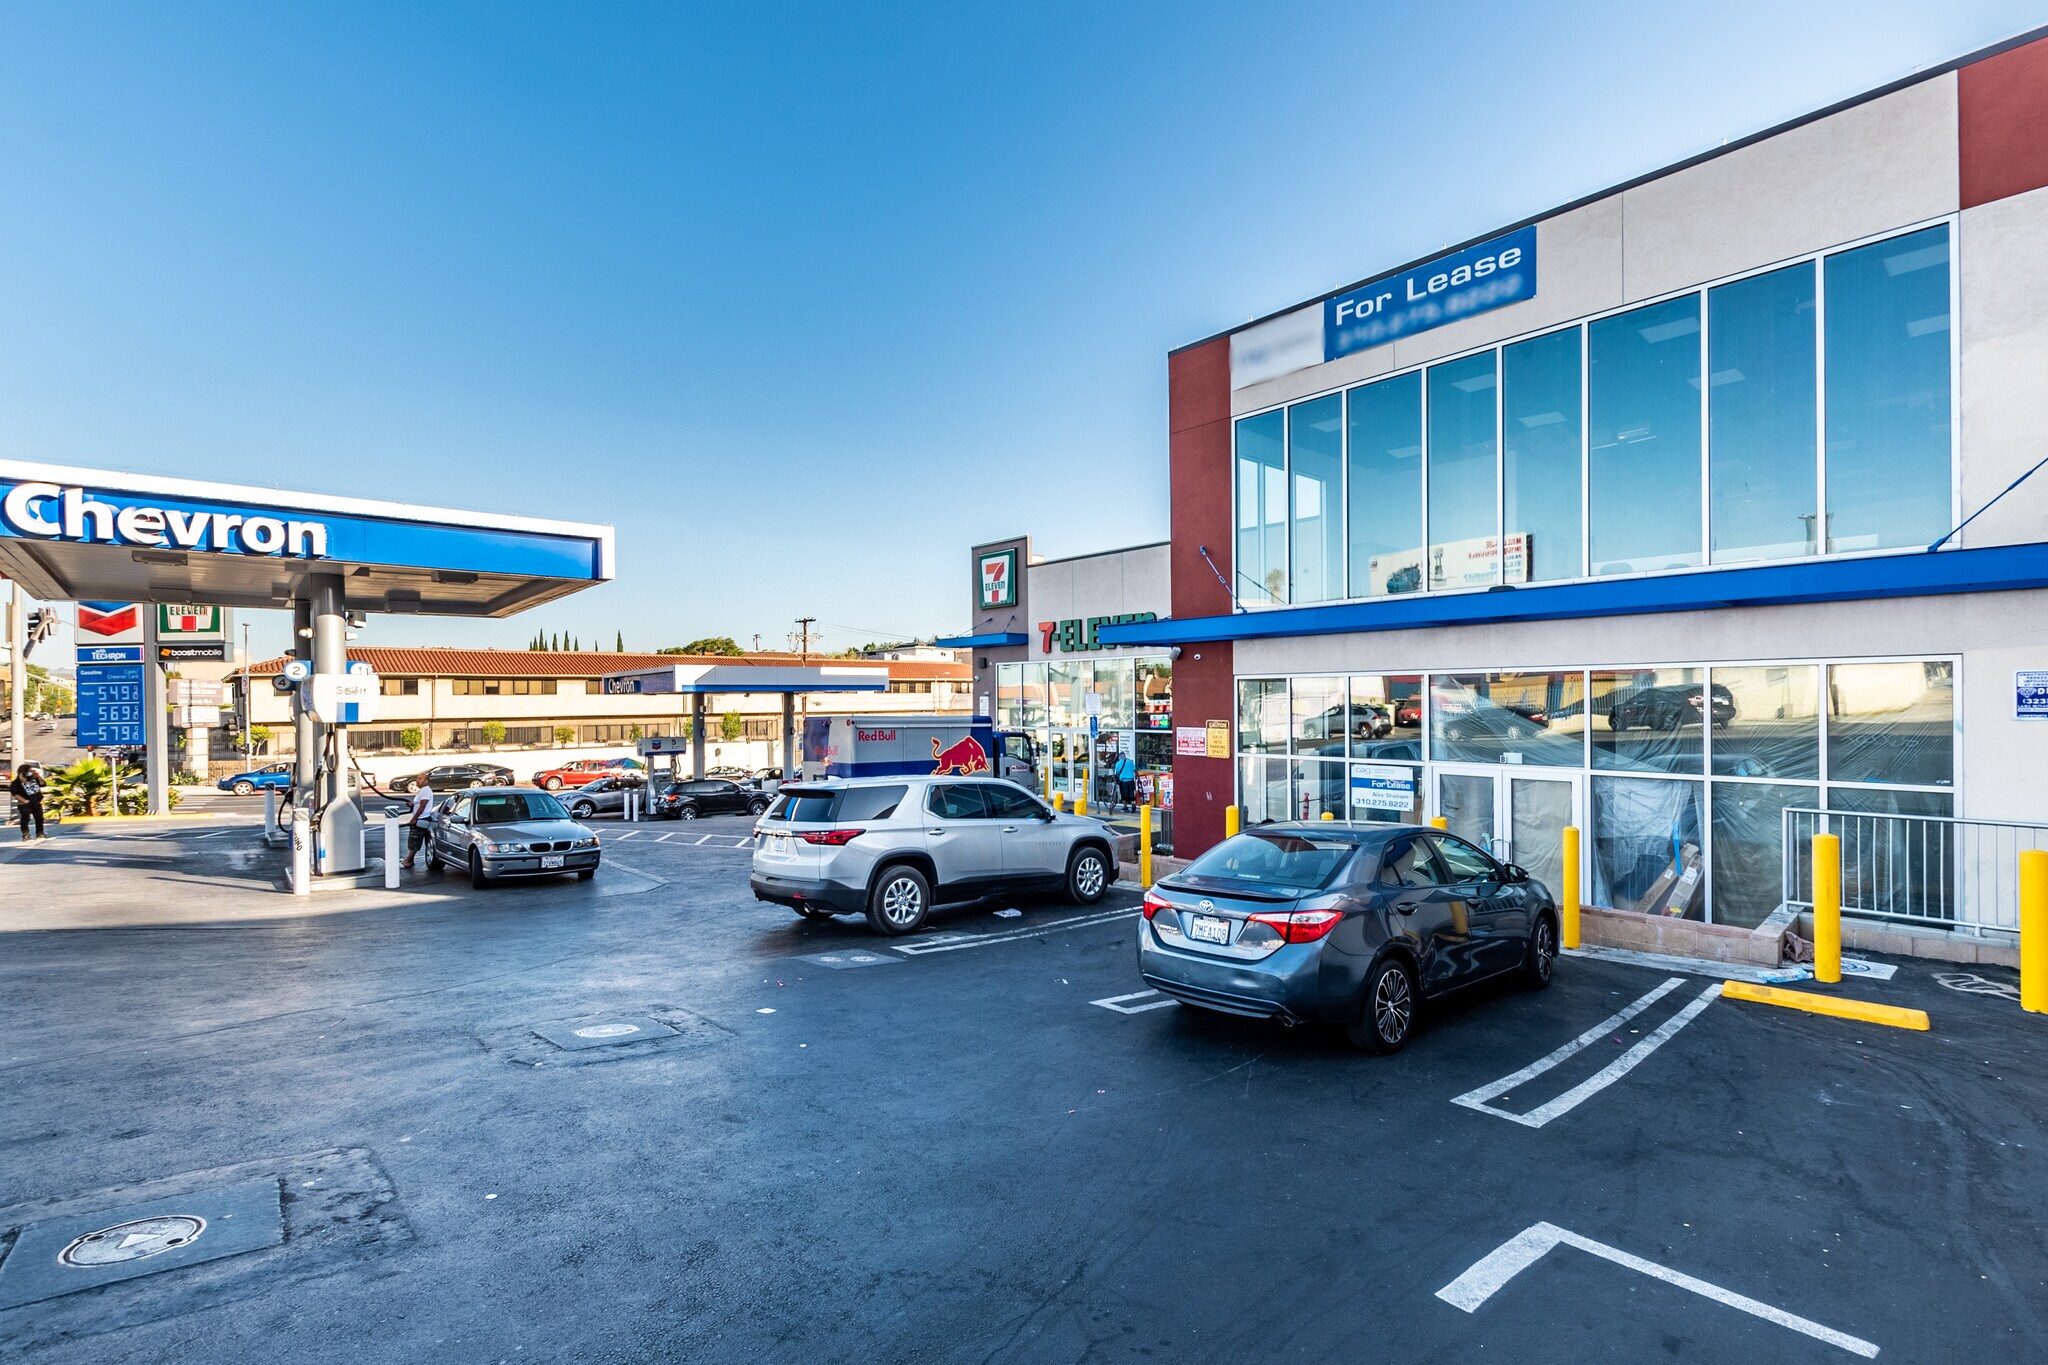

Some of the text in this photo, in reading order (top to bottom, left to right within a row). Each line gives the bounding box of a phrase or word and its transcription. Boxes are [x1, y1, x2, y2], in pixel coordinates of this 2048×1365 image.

[1336, 292, 1392, 326] For
[1406, 247, 1522, 302] Lease
[4, 482, 327, 555] Chevron
[985, 562, 1005, 602] 7
[1038, 612, 1157, 653] 7-ELE
[91, 652, 127, 660] TECHRON
[292, 666, 301, 675] 2
[278, 678, 286, 687] 4
[608, 678, 635, 694] Chevron
[98, 685, 130, 701] 549
[98, 705, 130, 720] 569
[98, 726, 130, 741] 579
[858, 729, 896, 741] Red Bull
[827, 744, 839, 756] Bull
[1143, 779, 1152, 787] OFF
[1387, 781, 1411, 789] Lease
[1356, 798, 1408, 808] 310.275.8222
